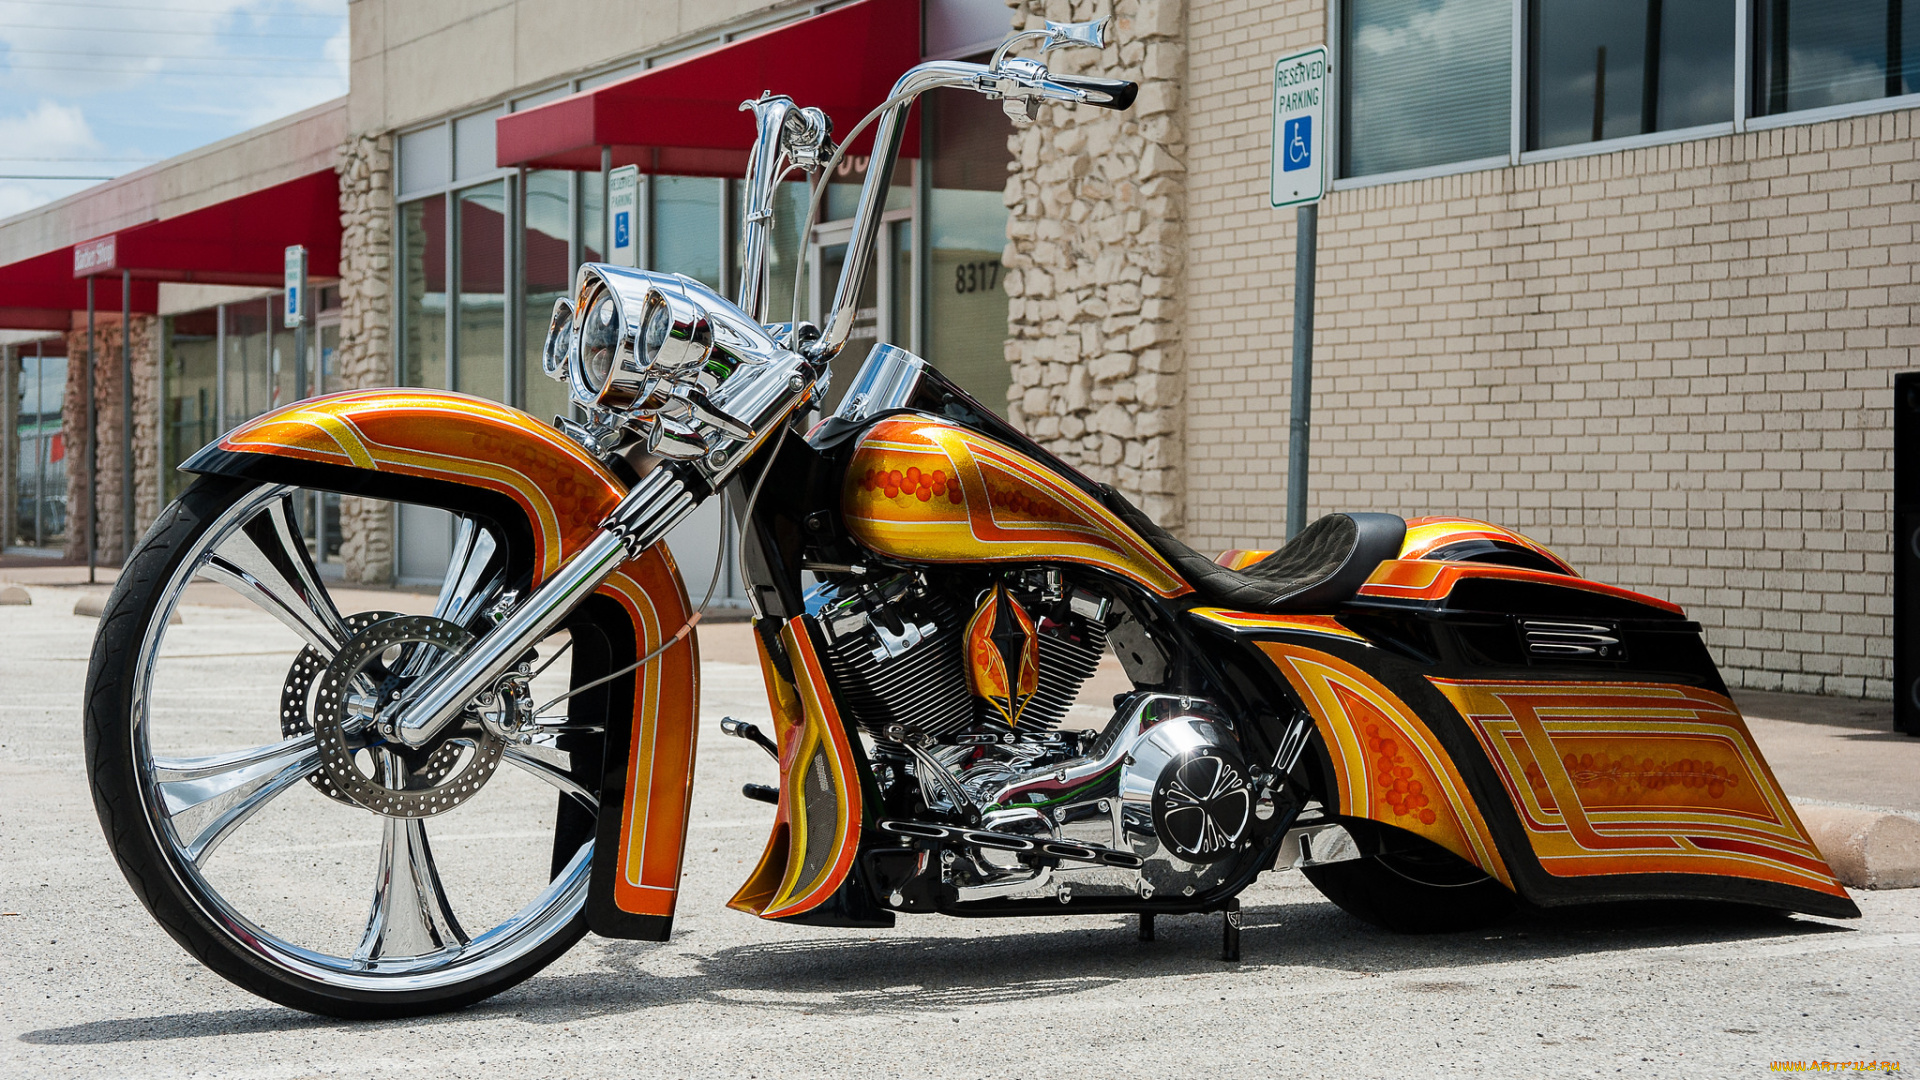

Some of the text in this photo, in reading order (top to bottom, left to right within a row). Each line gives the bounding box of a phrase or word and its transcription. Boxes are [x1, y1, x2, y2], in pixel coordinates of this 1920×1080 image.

[1278, 61, 1323, 88] RESERVED
[1279, 87, 1319, 114] PARKING
[956, 260, 999, 294] 8317
